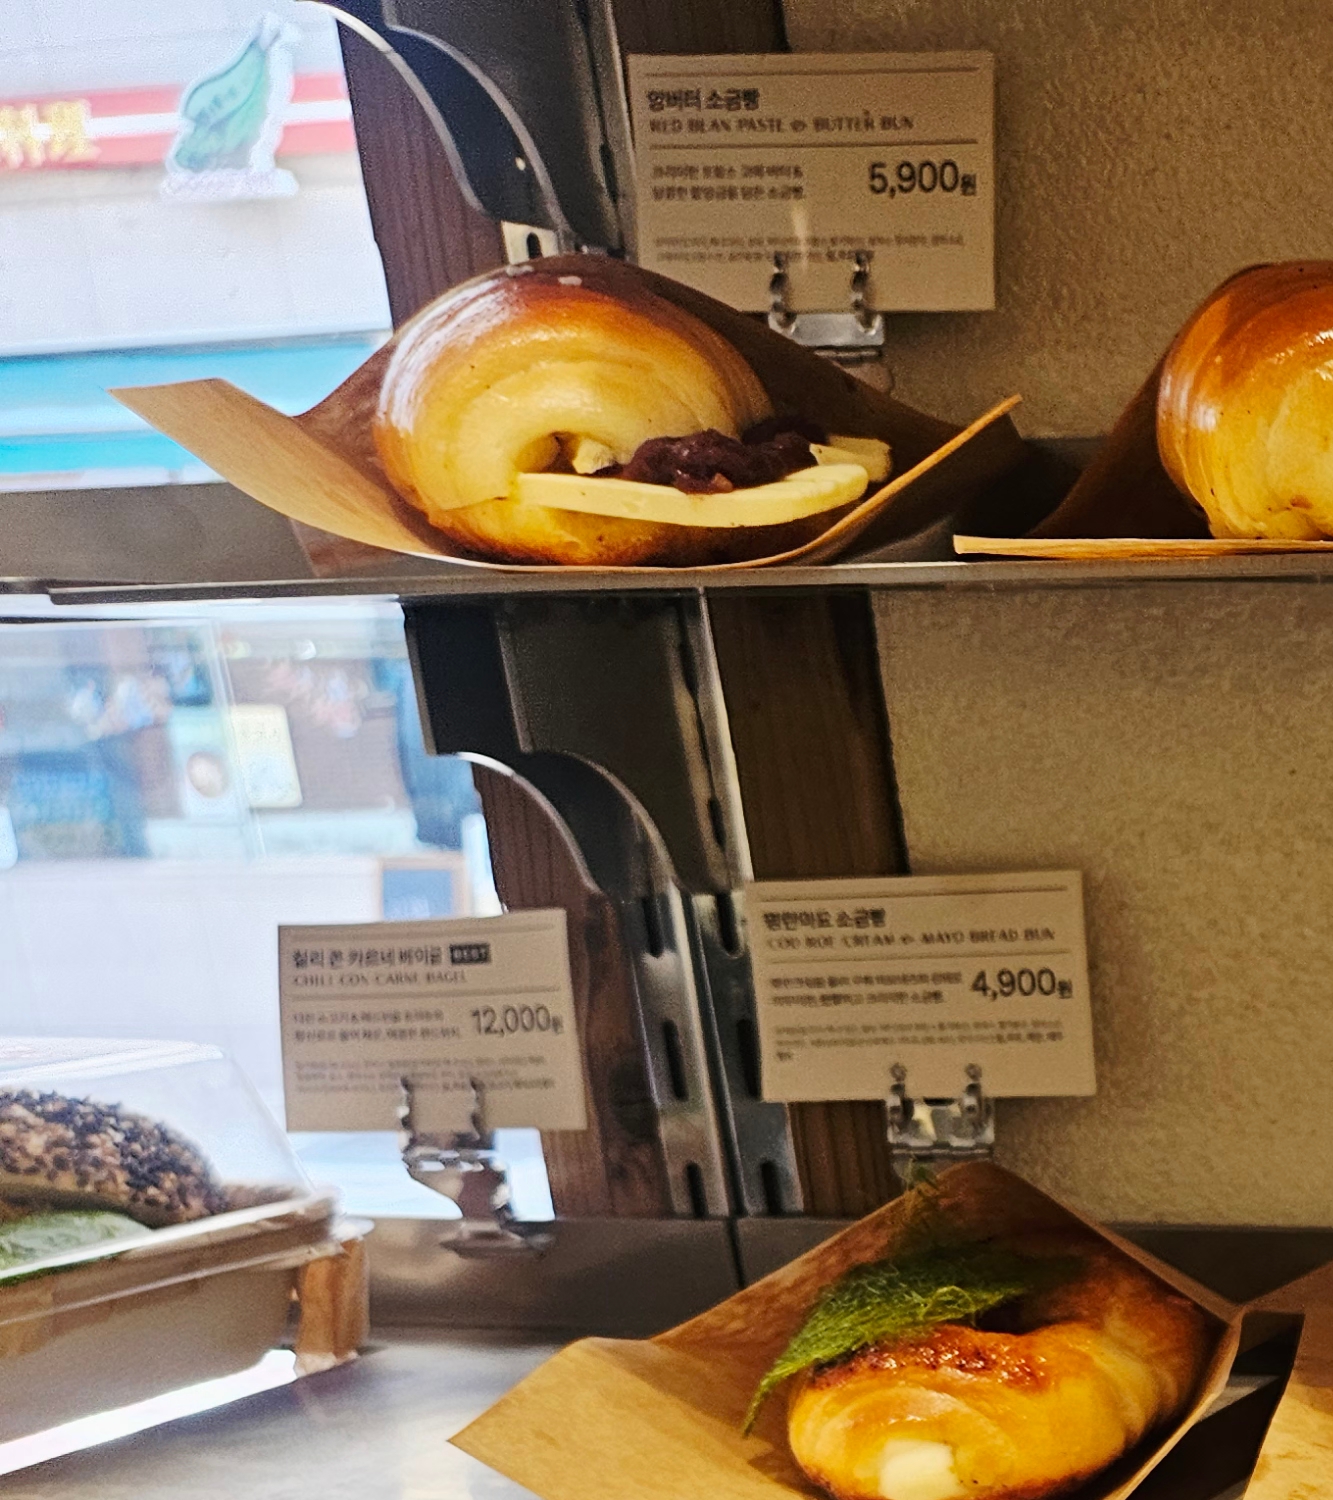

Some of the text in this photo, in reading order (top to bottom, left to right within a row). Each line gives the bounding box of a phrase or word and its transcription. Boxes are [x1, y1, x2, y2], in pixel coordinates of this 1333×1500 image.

[647, 88, 760, 111] 앙버터 소금빵
[649, 118, 683, 133] RED
[687, 118, 731, 133] BEAN
[737, 117, 784, 133] PASTE
[812, 116, 875, 132] BUTTER
[880, 115, 914, 131] BUN
[836, 907, 885, 929] 소금빵
[842, 932, 895, 948] CREAM
[921, 930, 964, 944] MAYO
[969, 928, 1018, 944] BREAD
[1024, 927, 1055, 942] BUN
[293, 946, 442, 970] 칠리 콘 카르네 베이글
[339, 973, 370, 986] CON
[375, 972, 418, 985] CARNE
[426, 970, 467, 984] BAGEL
